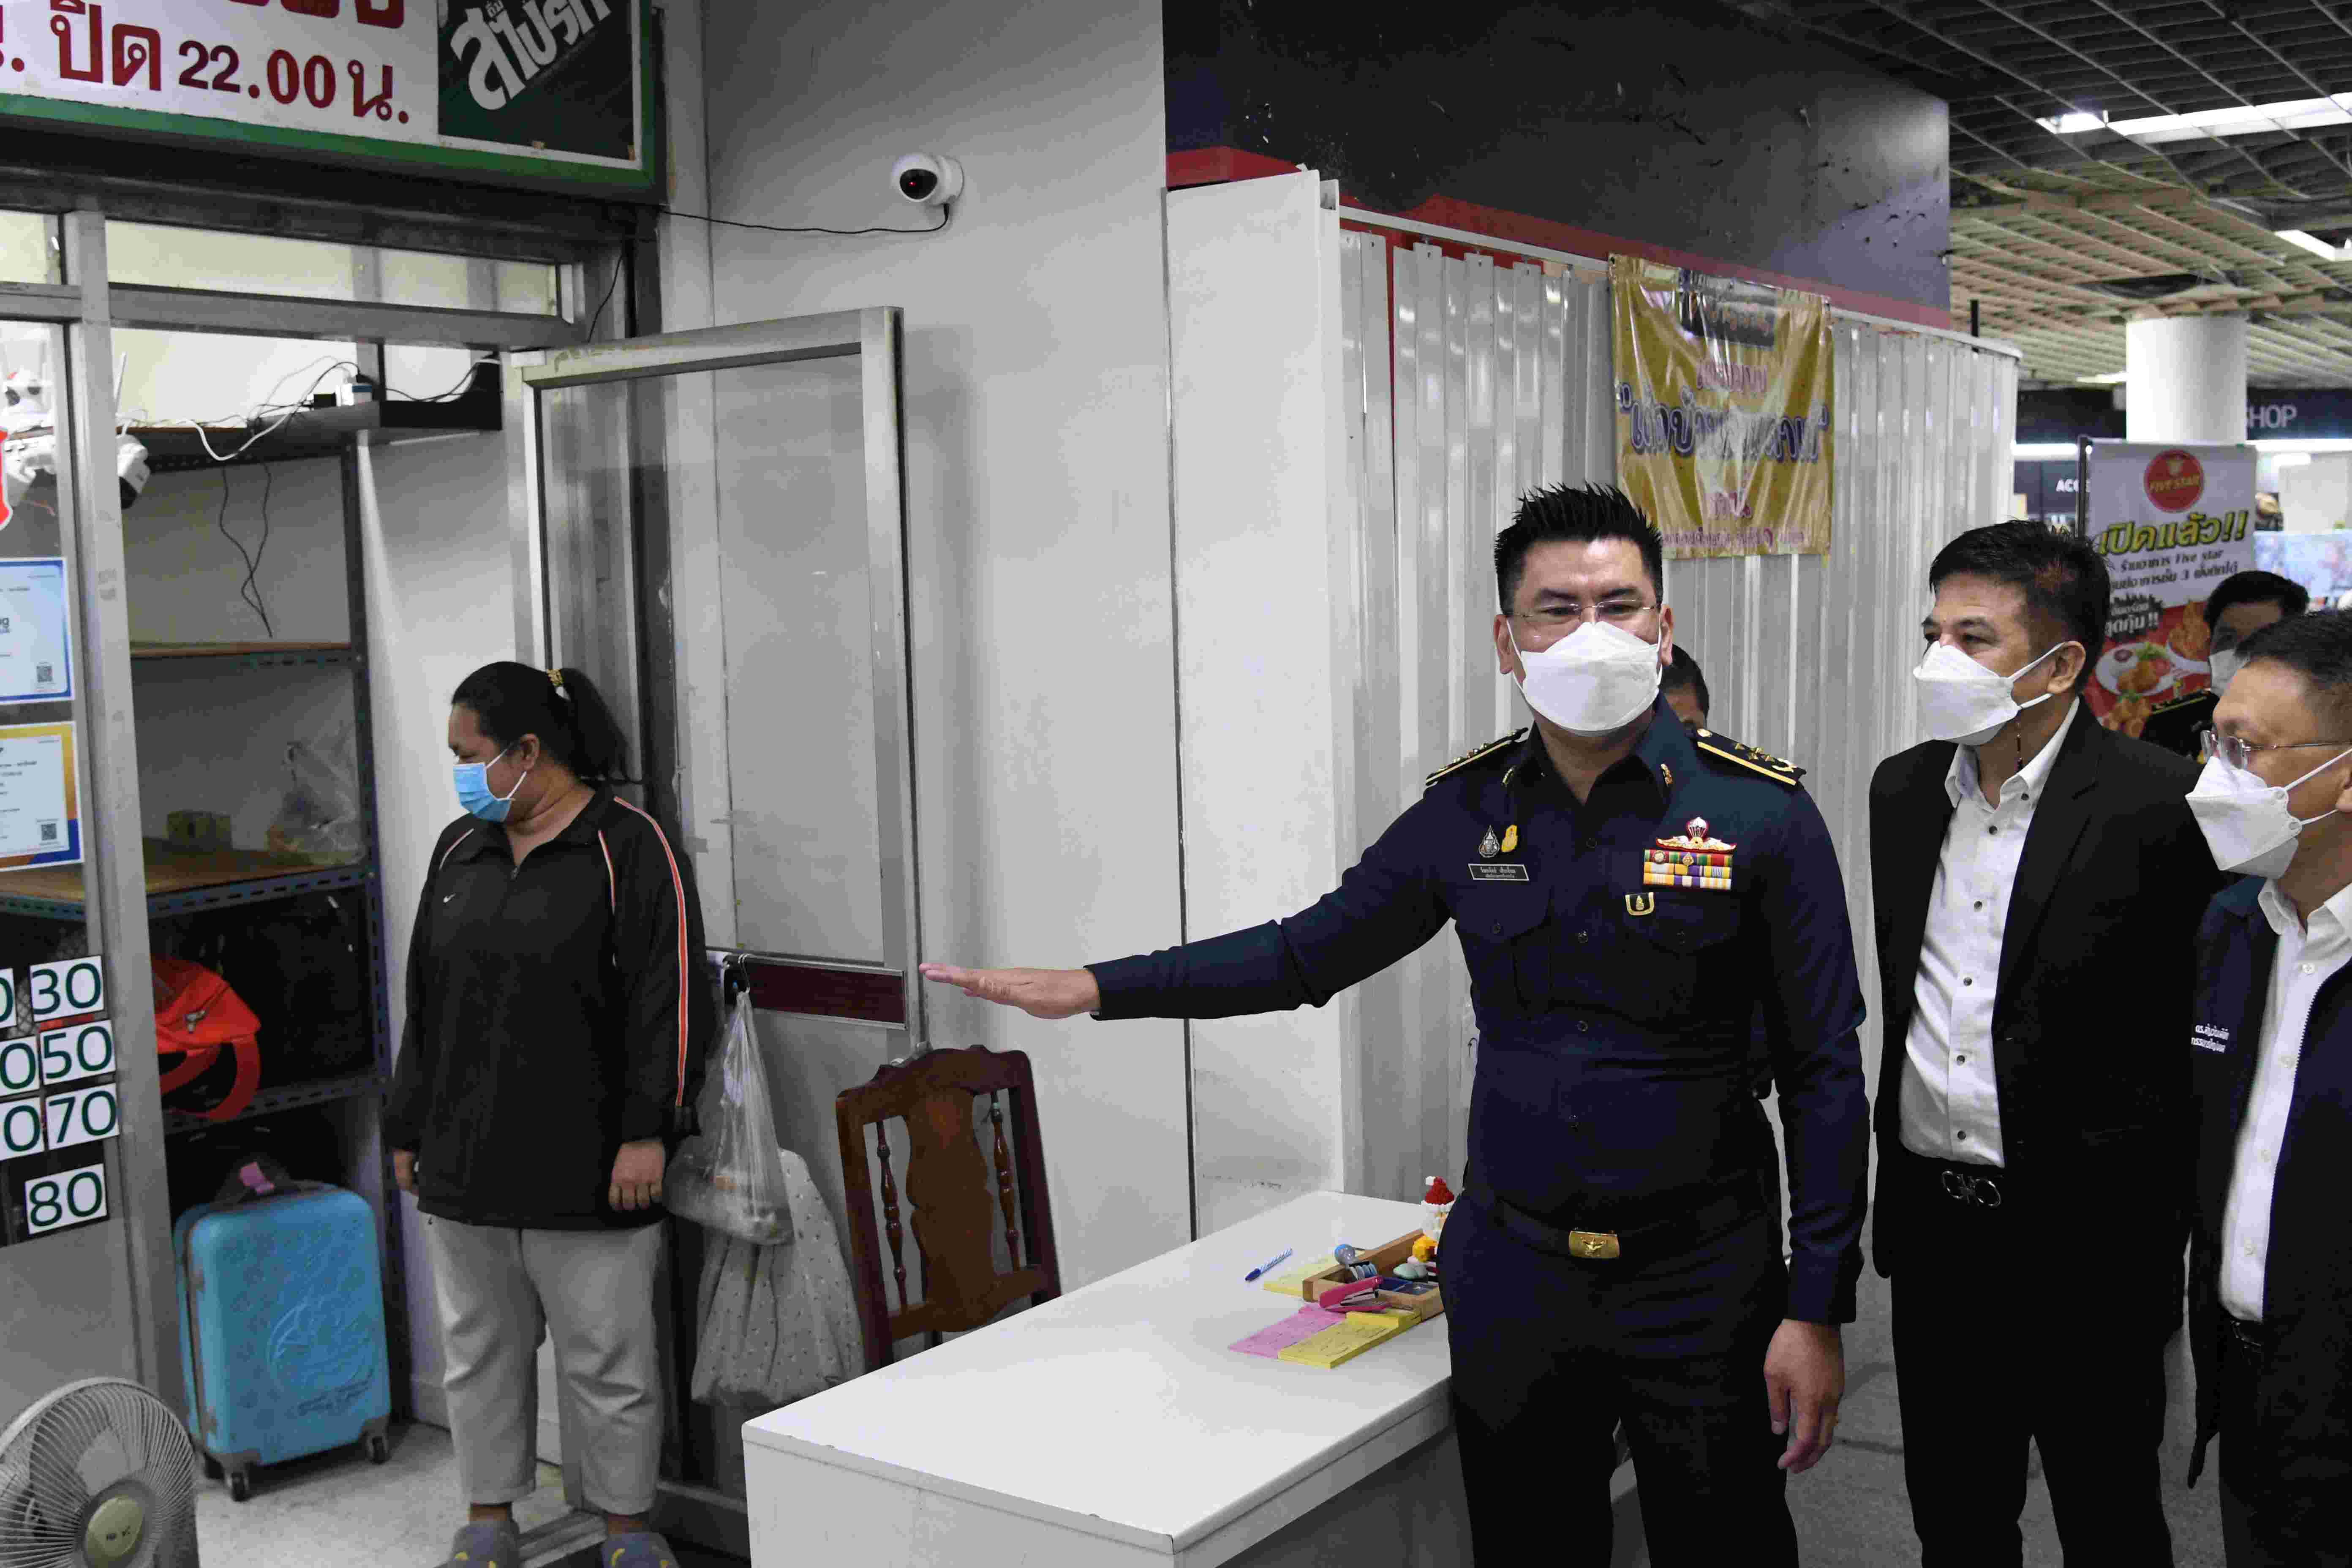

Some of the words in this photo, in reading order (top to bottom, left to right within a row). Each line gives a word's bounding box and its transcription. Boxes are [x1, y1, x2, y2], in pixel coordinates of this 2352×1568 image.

[2246, 405, 2298, 428] HOP
[2098, 510, 2249, 556] เปิดแล้ว!!
[32, 962, 102, 1015] 30
[44, 1026, 113, 1079] 50
[48, 1090, 117, 1143] 70
[29, 1171, 103, 1227] 80
